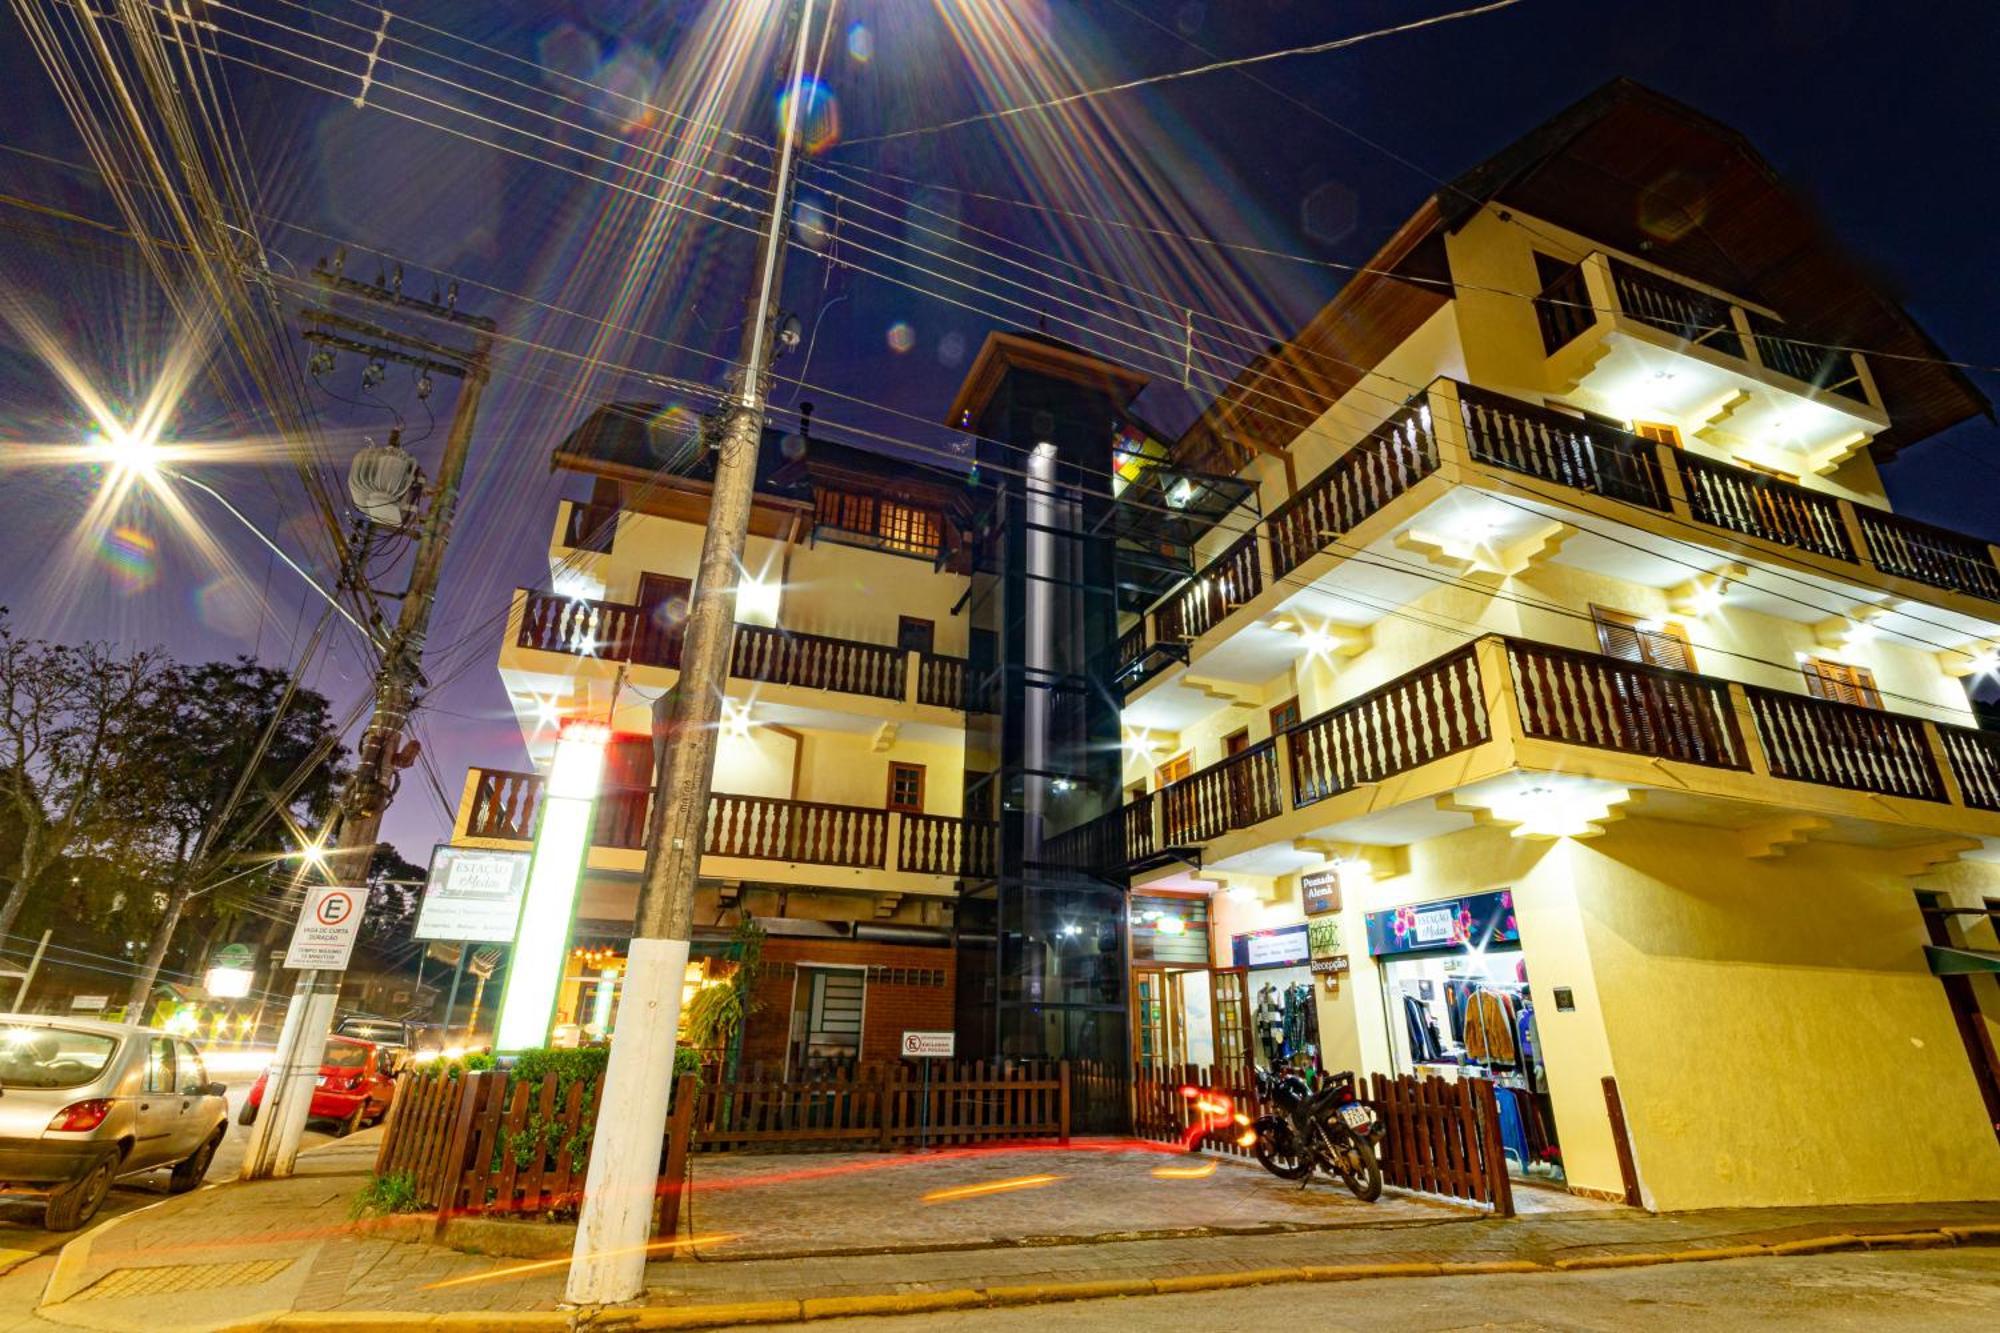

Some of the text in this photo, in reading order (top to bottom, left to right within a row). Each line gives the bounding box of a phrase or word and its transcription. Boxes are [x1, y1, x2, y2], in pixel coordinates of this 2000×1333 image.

[1308, 883, 1333, 898] Alemã
[324, 899, 343, 918] E
[1311, 957, 1347, 972] Recepção
